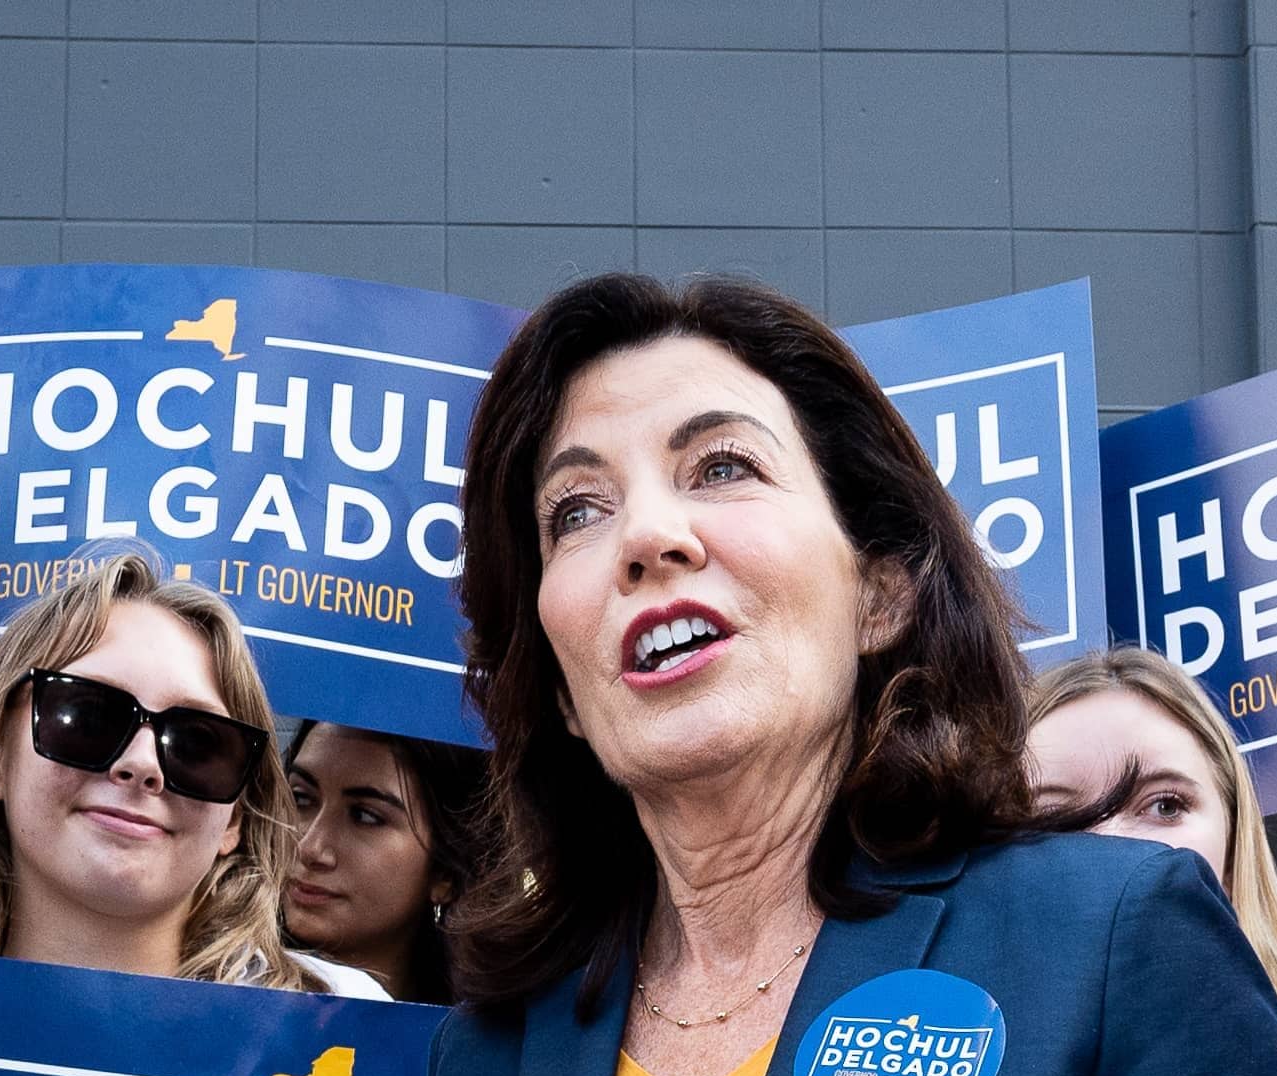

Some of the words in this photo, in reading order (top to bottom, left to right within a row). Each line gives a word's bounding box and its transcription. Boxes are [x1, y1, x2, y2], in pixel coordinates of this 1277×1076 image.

[218, 559, 250, 596] LT
[257, 564, 414, 627] GOVERNOR
[829, 1026, 979, 1059] HOCHUL
